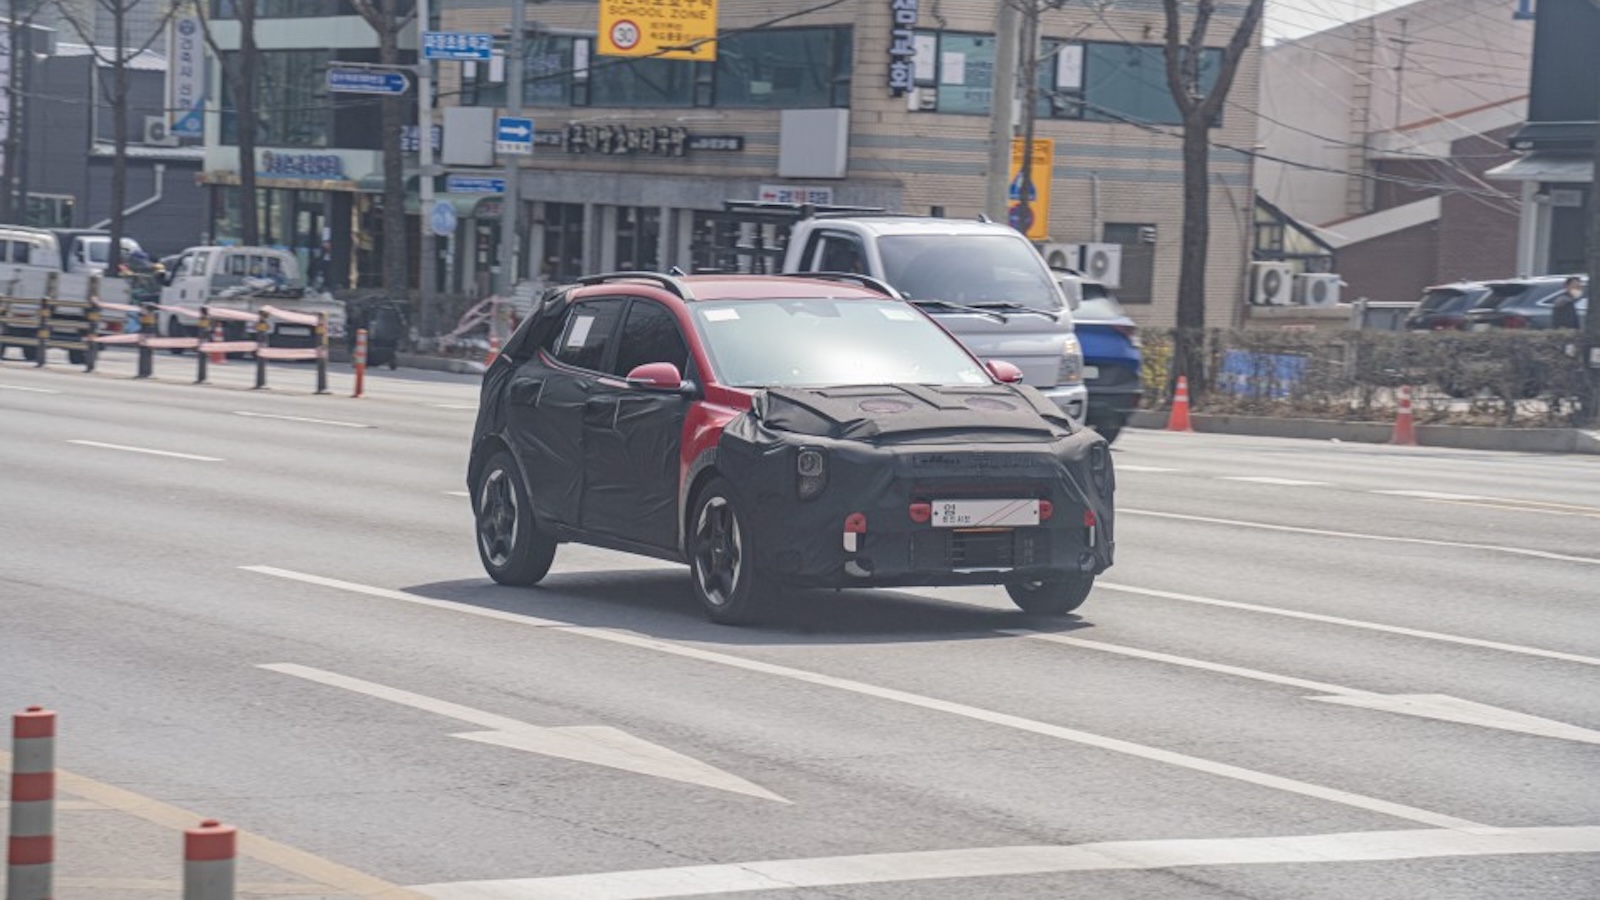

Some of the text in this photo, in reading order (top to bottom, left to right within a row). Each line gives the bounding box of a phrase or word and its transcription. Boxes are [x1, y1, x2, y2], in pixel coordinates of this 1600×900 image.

[609, 5, 707, 20] SCHOOL ZONE
[617, 27, 635, 43] 30
[944, 503, 956, 515] 임
